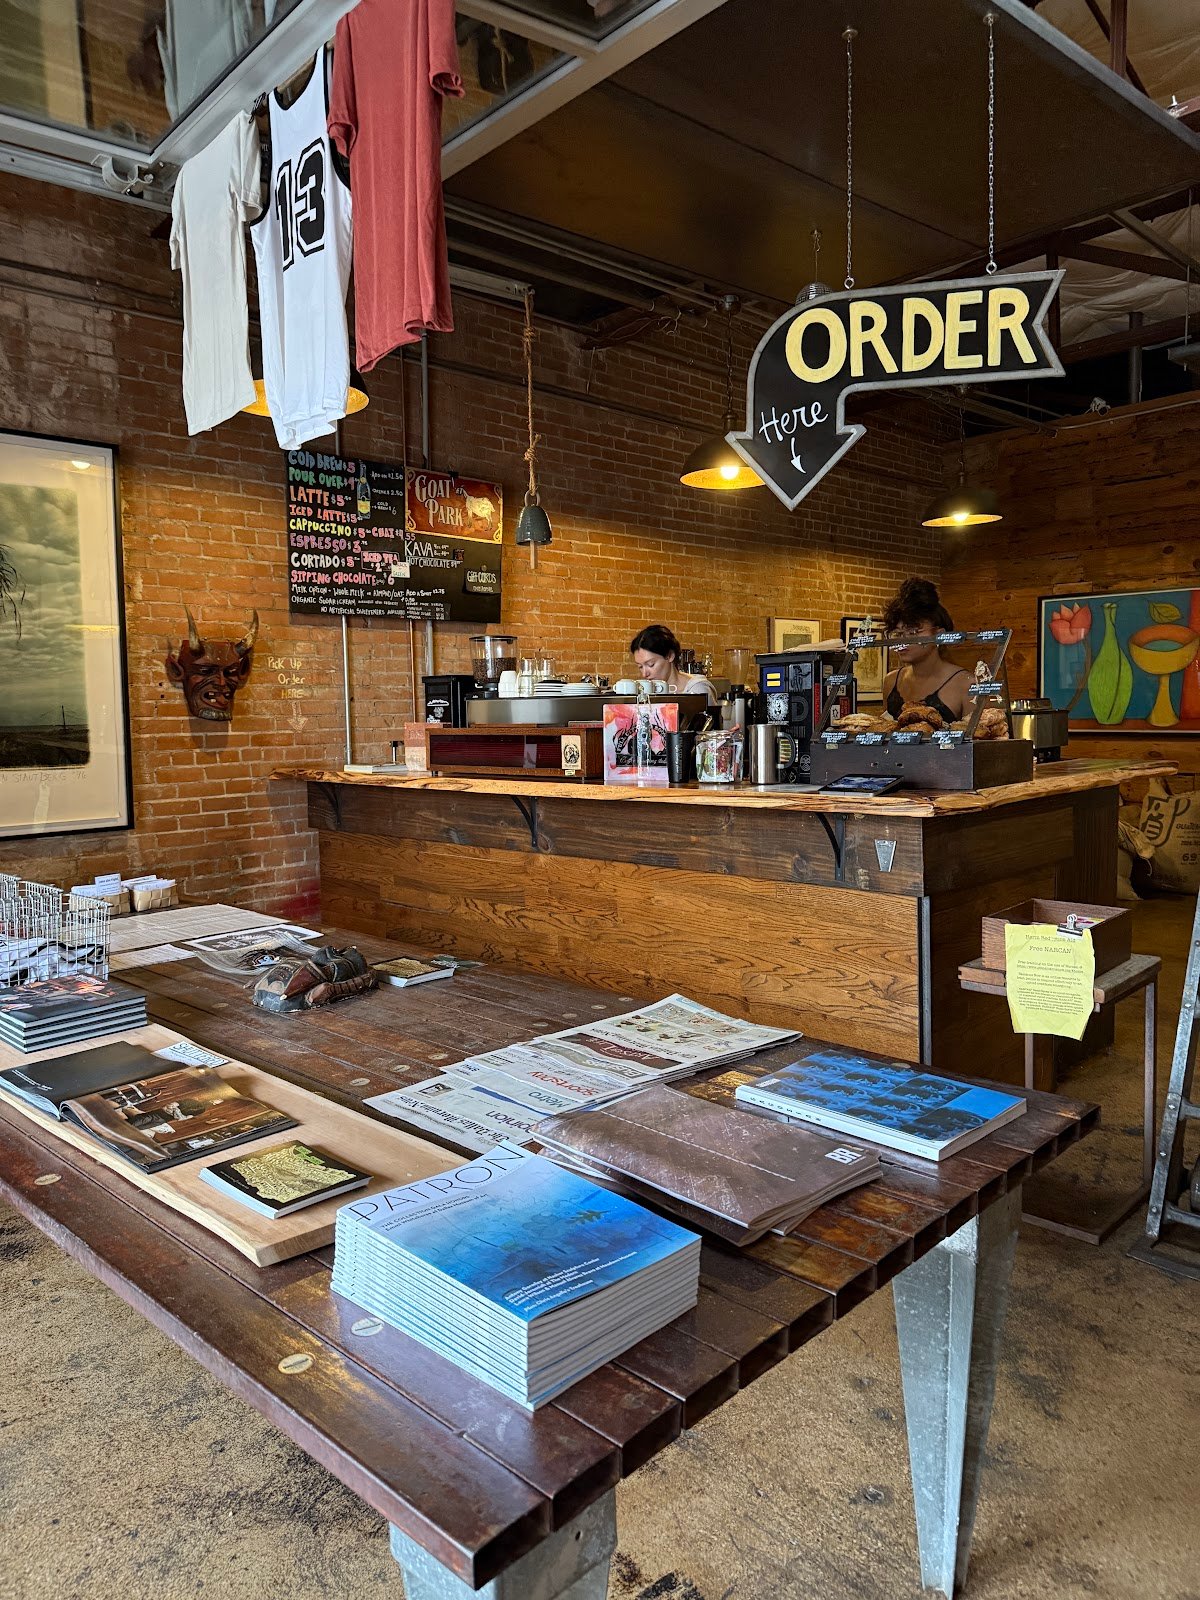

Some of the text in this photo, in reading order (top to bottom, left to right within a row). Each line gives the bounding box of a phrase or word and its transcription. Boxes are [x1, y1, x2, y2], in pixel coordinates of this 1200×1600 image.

[275, 136, 325, 272] 13
[786, 288, 1037, 383] ORDER
[758, 401, 829, 444] Here
[317, 453, 342, 471] BREW
[289, 467, 344, 489] POUR OVER
[290, 485, 329, 506] LATTE
[414, 474, 452, 503] GOAT
[289, 504, 313, 517] ICED
[317, 508, 346, 523] LATTE
[424, 498, 464, 529] PARK
[290, 518, 351, 536] CAPPUCCINO
[372, 527, 394, 538] CHAI
[290, 533, 347, 553] ESPRESSO
[404, 540, 434, 557] KAVA
[291, 552, 340, 568] CORTADO
[382, 553, 398, 563] TEA
[405, 557, 418, 567] HOT
[418, 559, 450, 569] CHOCOLATE
[291, 570, 331, 585] SIPPING
[291, 595, 317, 604] ORGANIC
[278, 673, 305, 685] Order
[281, 688, 304, 699] HERE
[1044, 946, 1072, 954] NARCAN
[397, 1095, 421, 1108] News
[459, 1118, 489, 1136] Dallas
[349, 1144, 526, 1222] PATRON
